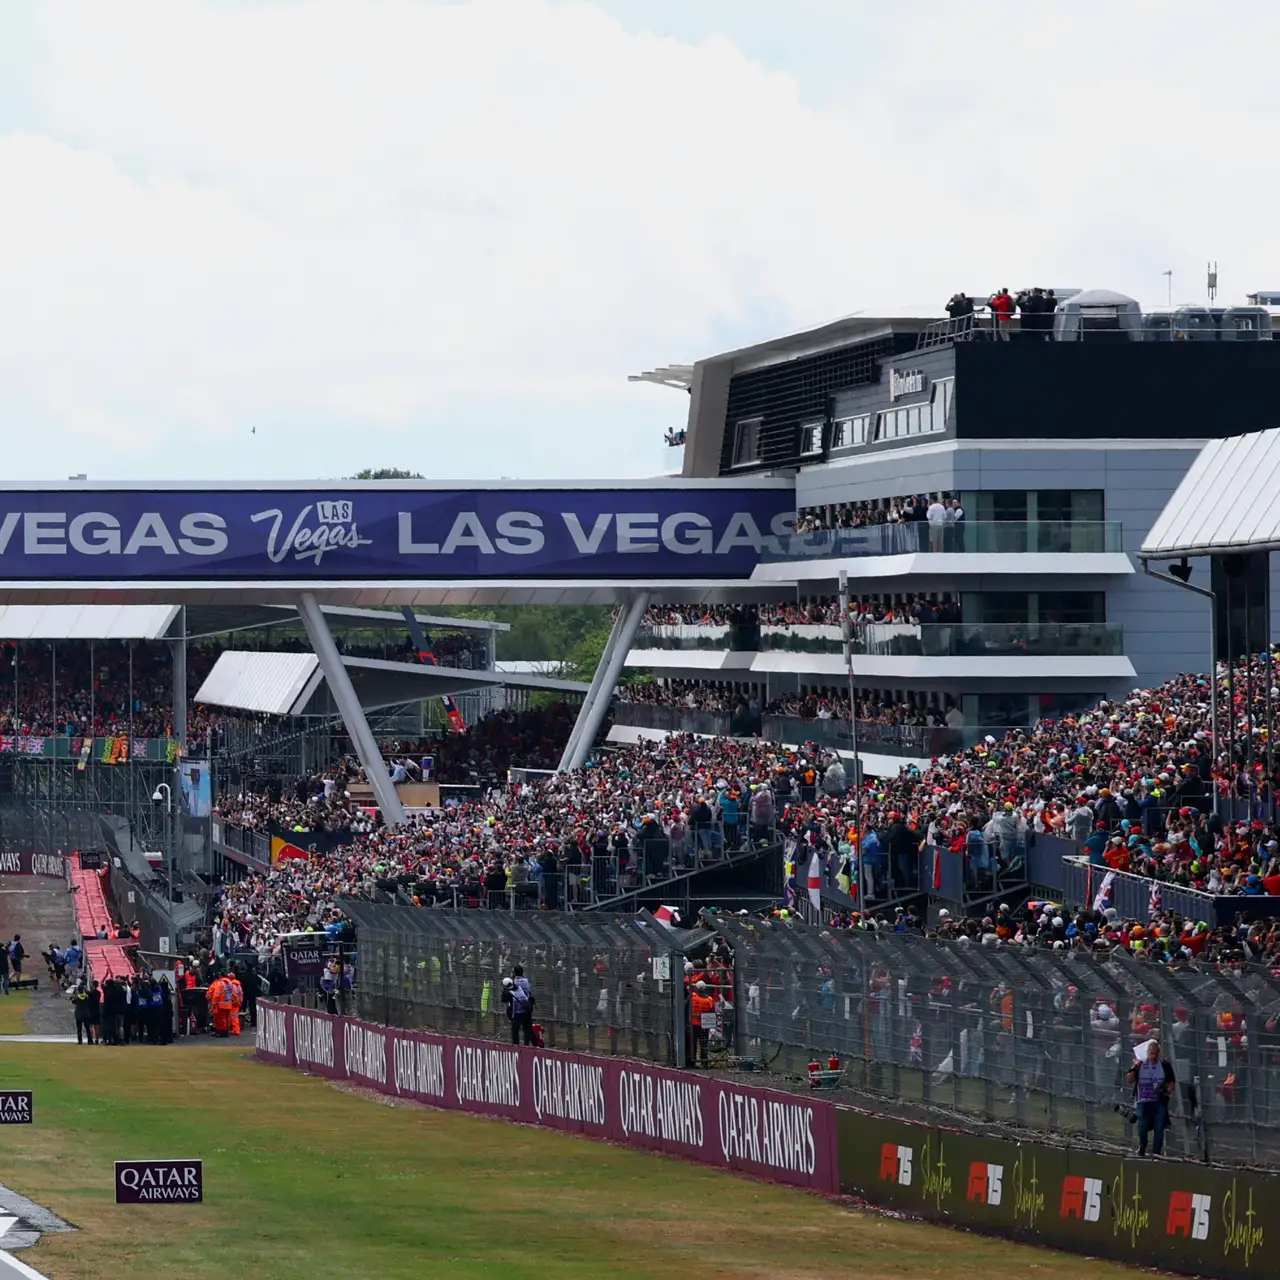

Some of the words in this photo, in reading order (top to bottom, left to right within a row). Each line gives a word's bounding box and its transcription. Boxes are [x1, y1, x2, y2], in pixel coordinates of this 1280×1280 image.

[251, 506, 372, 566] Vegas
[320, 502, 350, 521] LAS
[398, 512, 544, 554] LAS
[290, 950, 320, 961] QATAR
[393, 1038, 416, 1094] QATAR
[455, 1045, 484, 1104] QATAR
[485, 1049, 520, 1107] AIRWAYS
[533, 1056, 564, 1119] QATAR
[564, 1062, 605, 1125] AIRWAYS
[619, 1070, 655, 1137] QATAR
[656, 1077, 704, 1147] AIRWAYS
[718, 1090, 761, 1162] QATAR
[762, 1099, 815, 1175] AIRWAYS
[121, 1168, 198, 1190] QATAR
[139, 1187, 199, 1199] AIRWAYS
